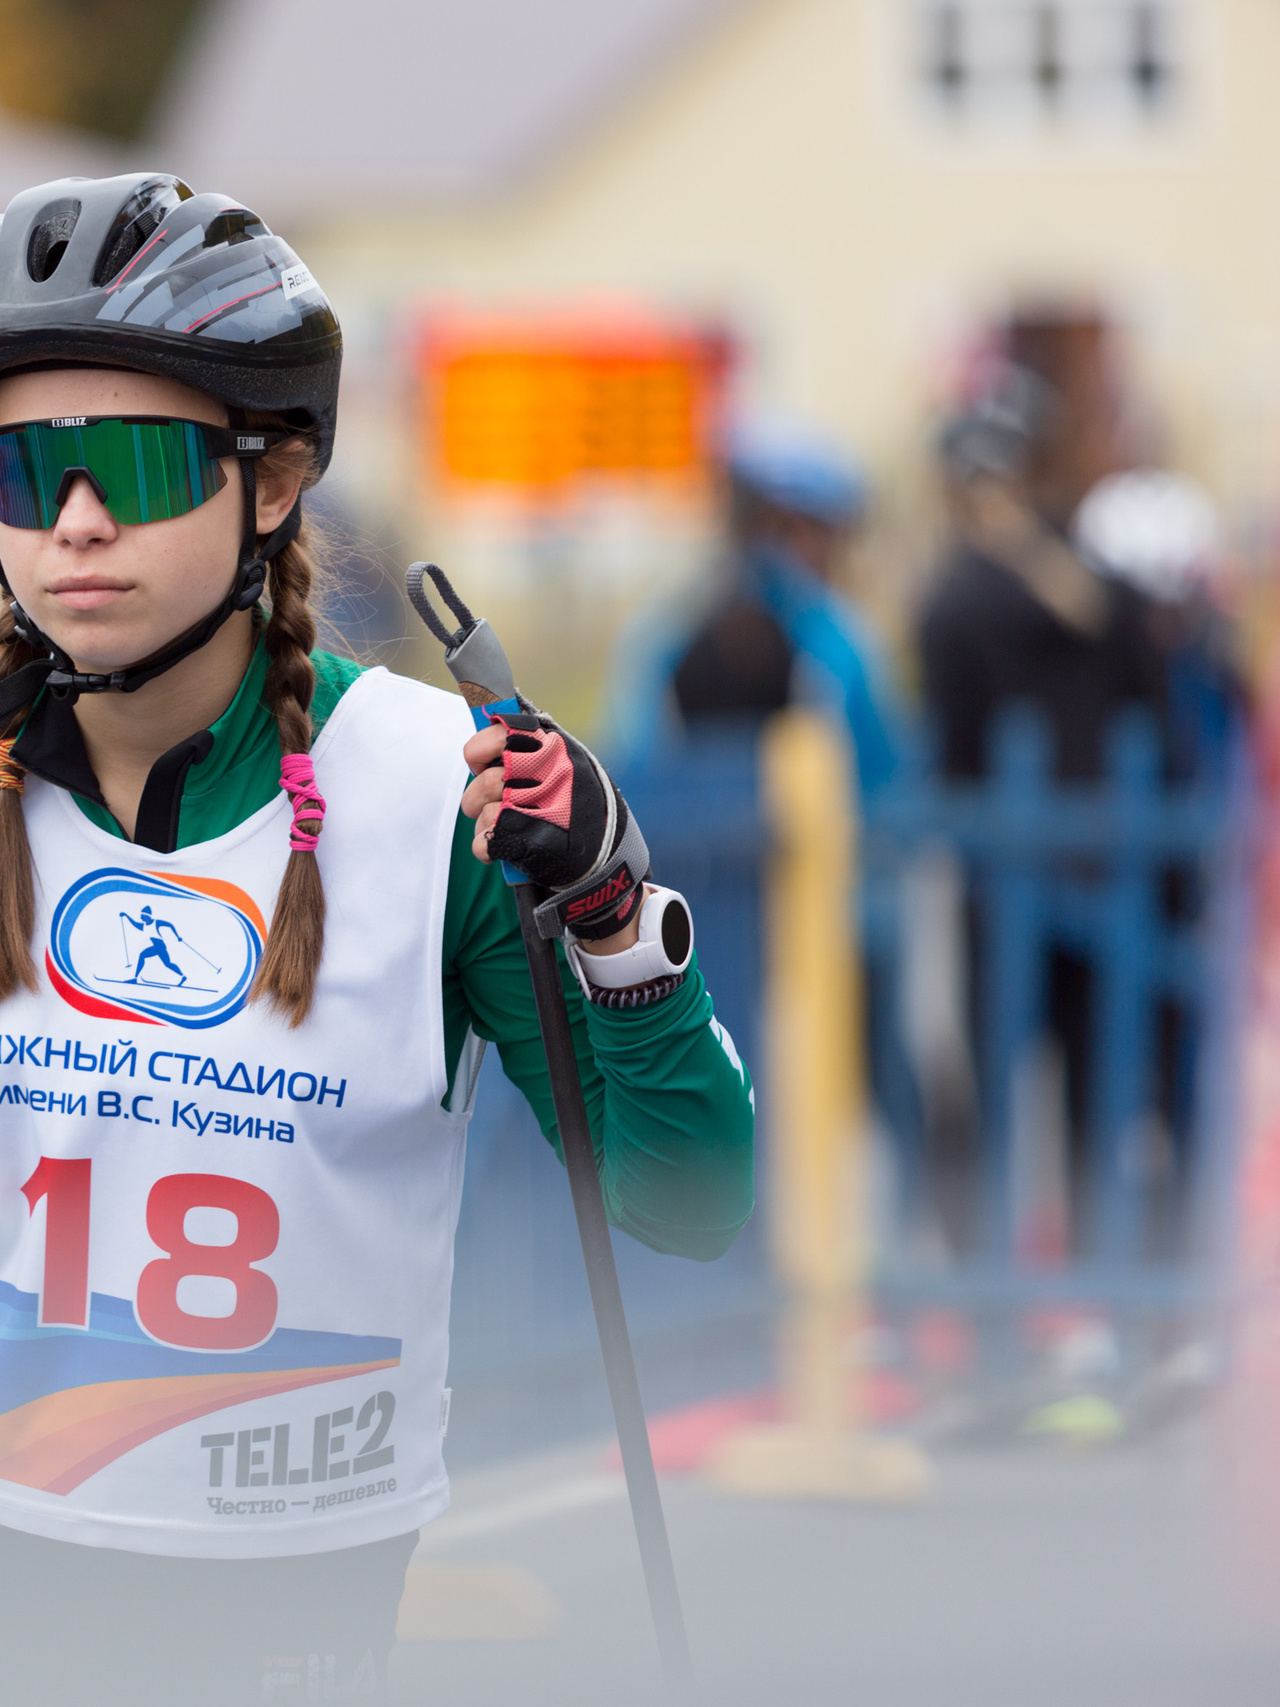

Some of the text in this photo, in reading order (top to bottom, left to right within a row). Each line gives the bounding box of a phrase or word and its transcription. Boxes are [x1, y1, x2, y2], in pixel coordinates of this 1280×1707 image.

[65, 417, 87, 427] BLIZ
[248, 436, 265, 450] BLIZ
[147, 1051, 347, 1107] СТАДИОН
[97, 1090, 160, 1124] В.С.
[172, 1100, 295, 1143] Кузина
[20, 1156, 280, 1350] 18
[200, 1391, 396, 1488] TELE2
[206, 1496, 286, 1515] Честно
[312, 1477, 397, 1512] дешевле
